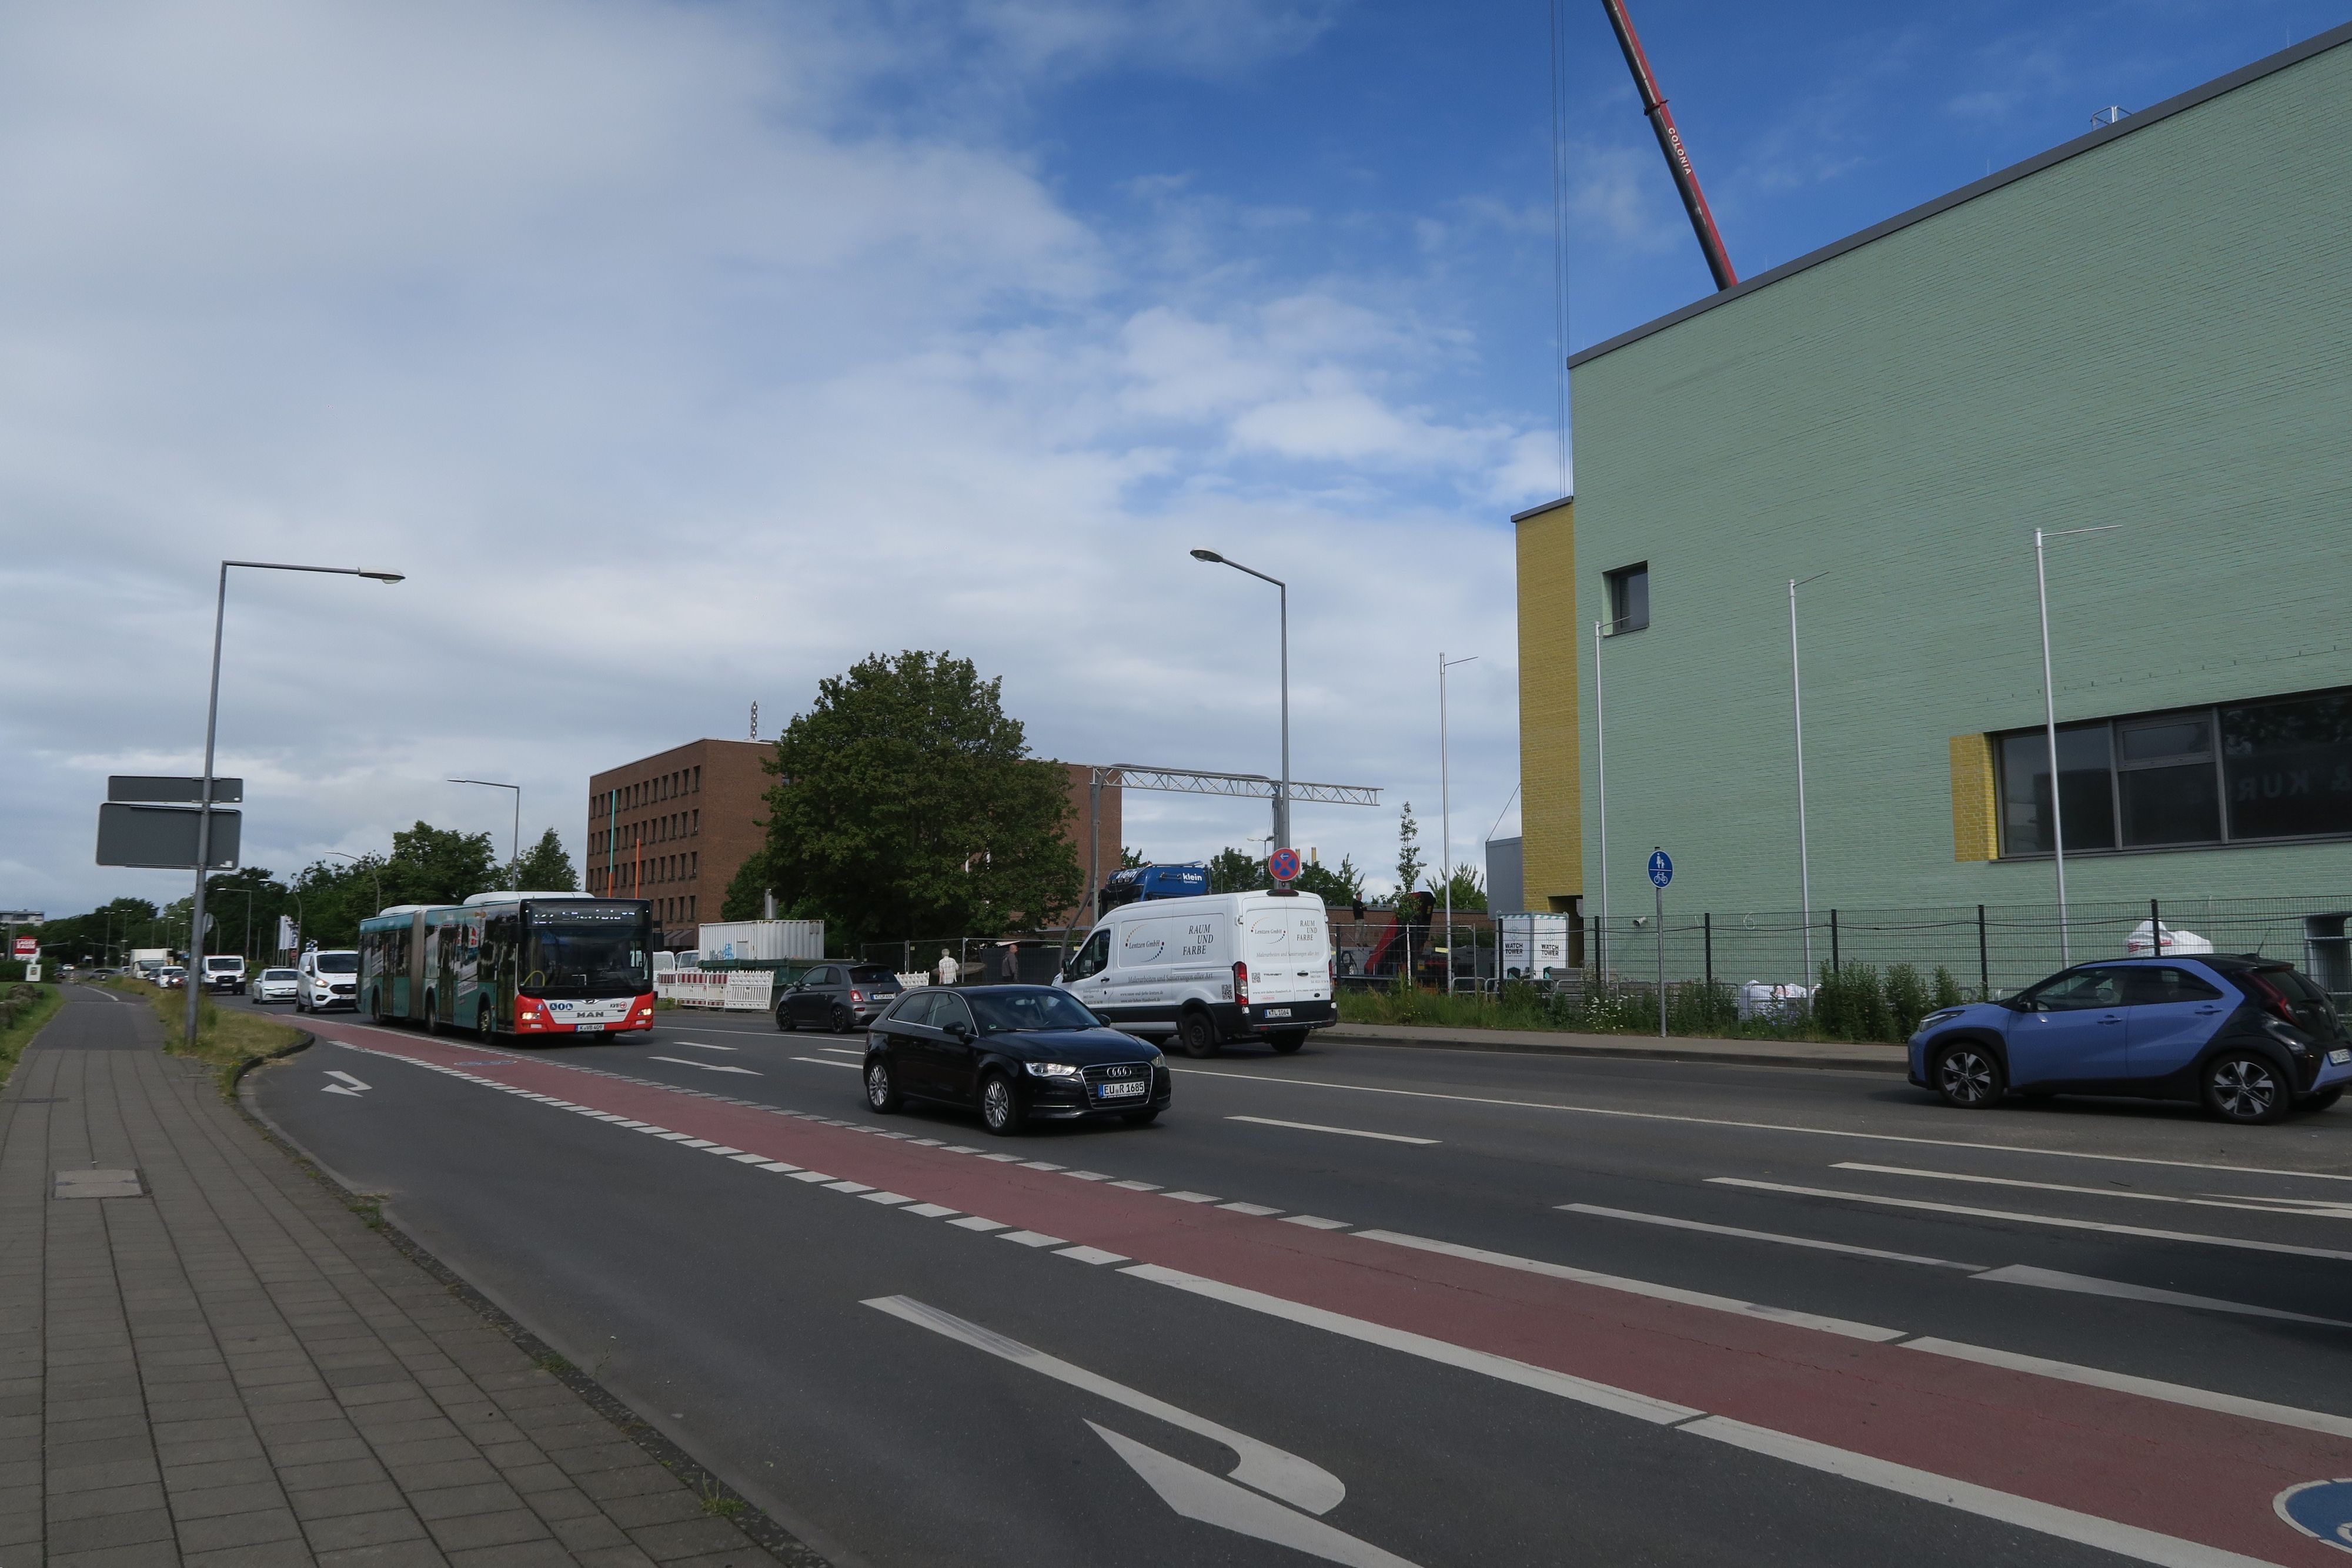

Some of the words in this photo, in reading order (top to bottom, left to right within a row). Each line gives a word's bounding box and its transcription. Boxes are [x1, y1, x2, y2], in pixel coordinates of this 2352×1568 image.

[1668, 127, 1692, 175] COLONIA
[1116, 870, 1138, 879] klein
[1188, 924, 1211, 935] RAUM
[1197, 934, 1214, 944] UND
[1129, 941, 1145, 949] Lentzen
[1146, 940, 1160, 948] GmbH
[1182, 945, 1207, 955] FARBE
[1128, 975, 1156, 983] Malerarbeiten
[1166, 973, 1193, 982] Sanierungen
[1194, 972, 1204, 980] aller
[1104, 1085, 1114, 1094] EU
[1120, 1084, 1124, 1093] R
[1126, 1082, 1144, 1092] 1685
